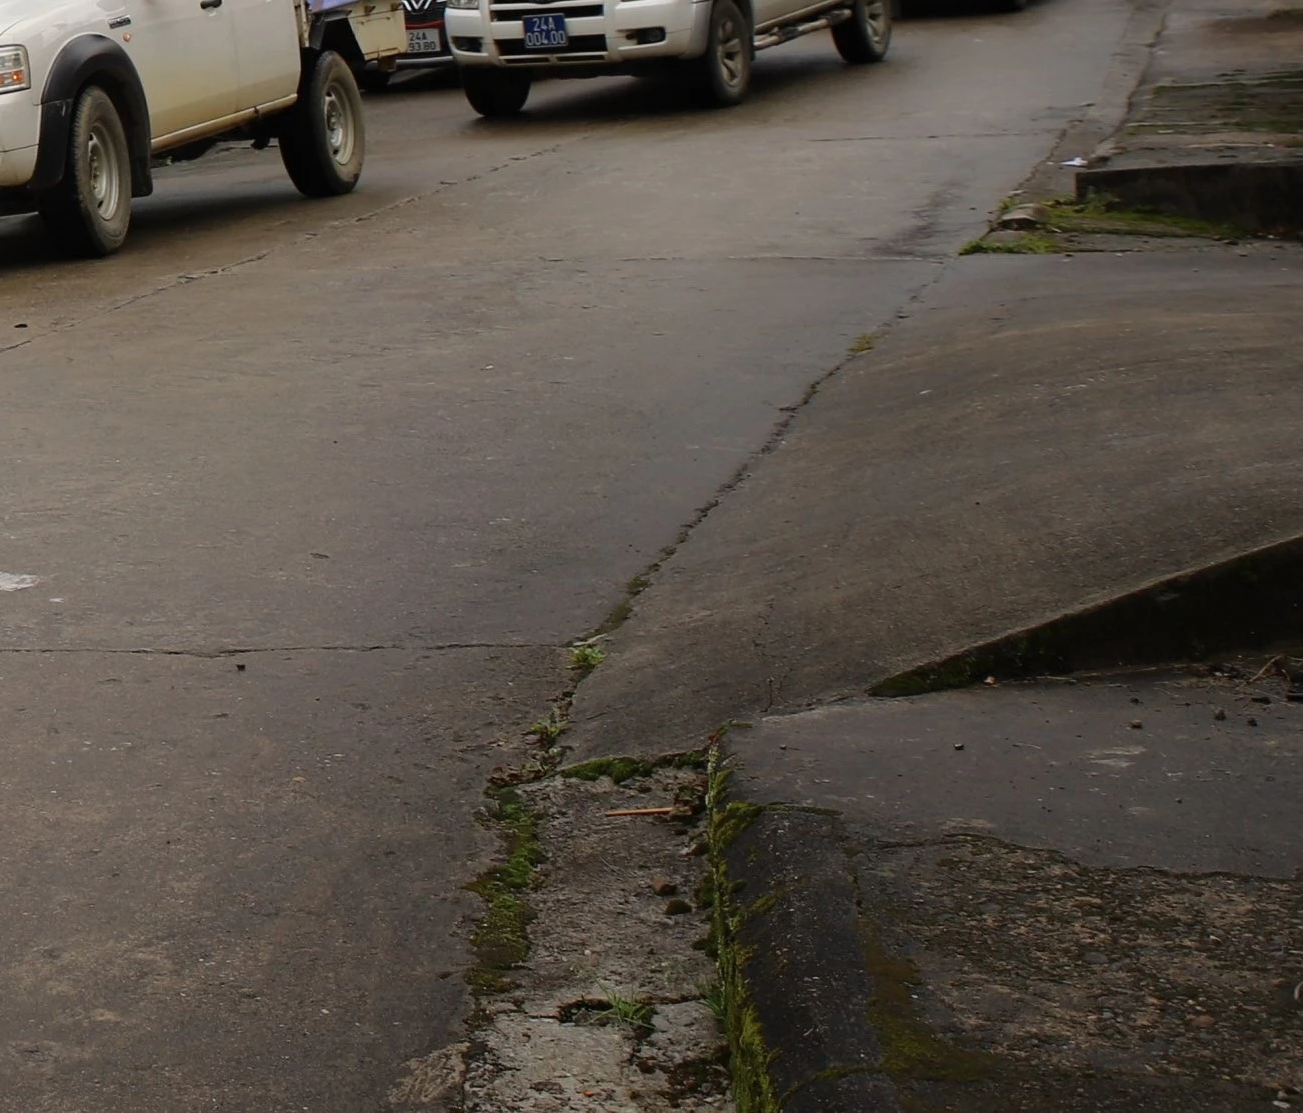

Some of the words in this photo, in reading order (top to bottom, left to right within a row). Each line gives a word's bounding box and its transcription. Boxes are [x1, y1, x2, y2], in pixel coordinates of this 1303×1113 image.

[532, 16, 556, 32] 24A
[409, 32, 427, 42] 24A
[525, 30, 567, 46] 004.00
